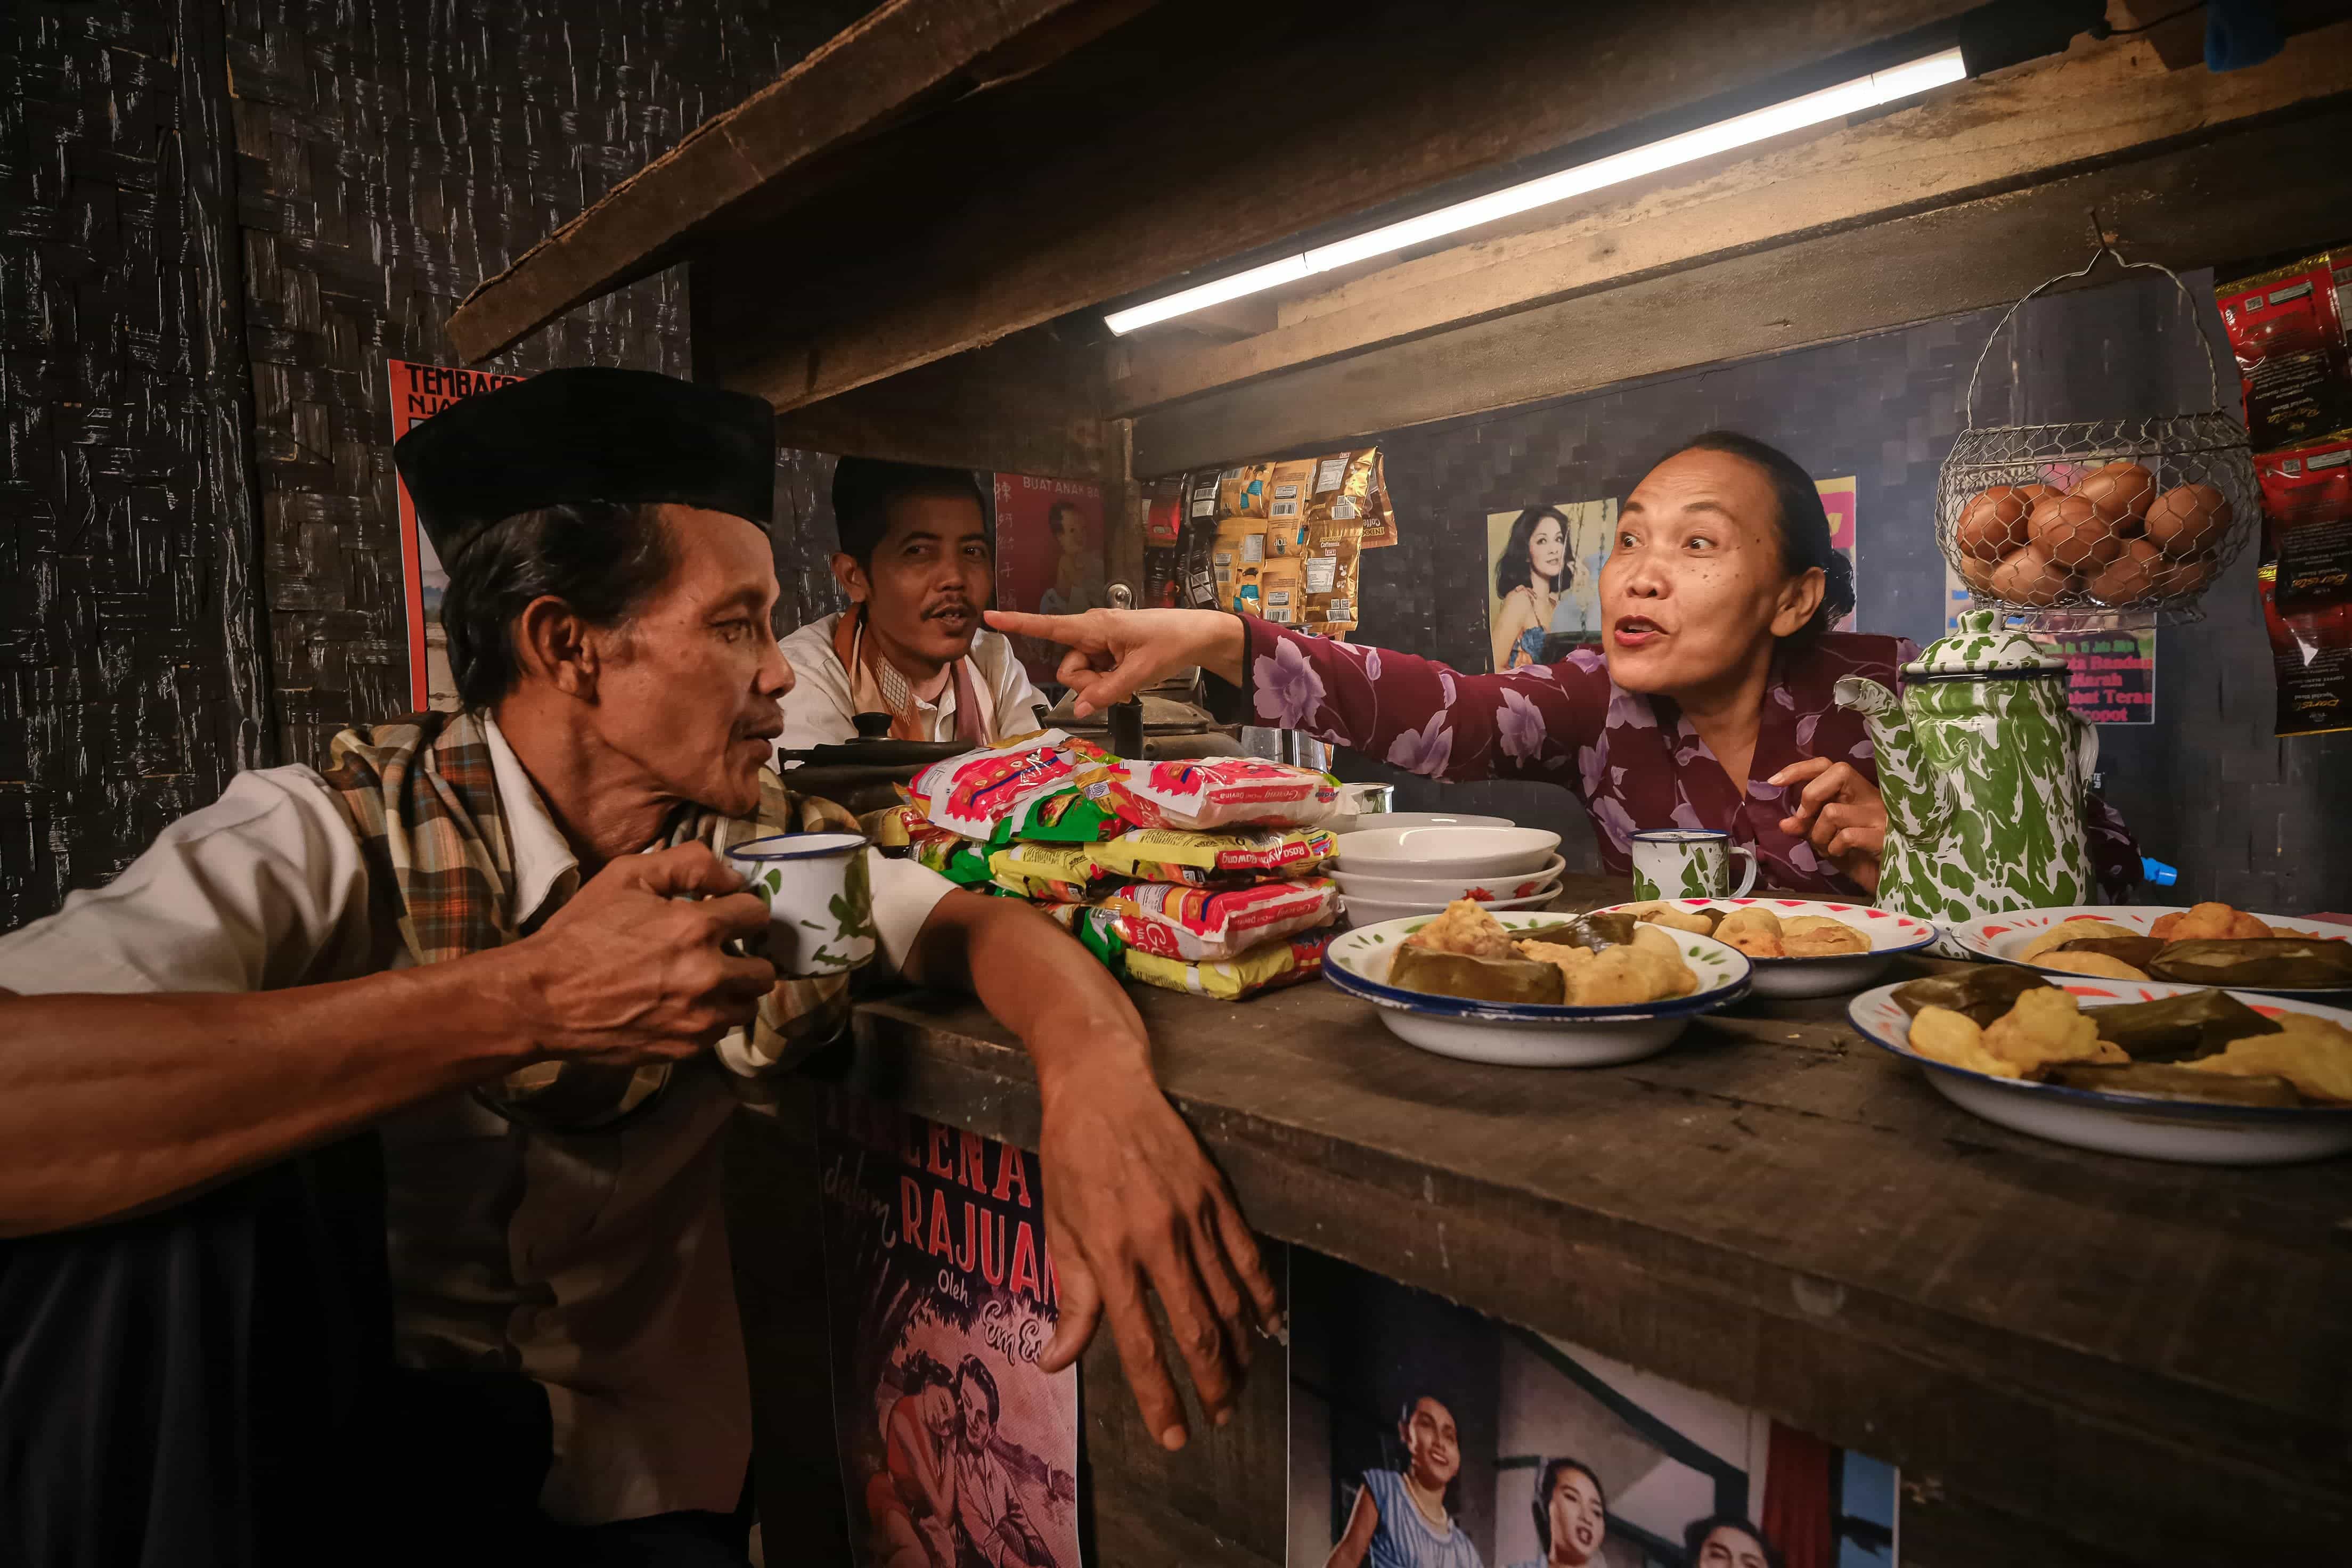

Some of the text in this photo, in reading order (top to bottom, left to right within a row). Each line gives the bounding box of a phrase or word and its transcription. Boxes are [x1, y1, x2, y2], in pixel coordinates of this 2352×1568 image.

[1022, 476, 1052, 492] BUAT
[1055, 480, 1084, 495] ANAK
[1274, 537, 1287, 546] TOP
[2070, 673, 2122, 688] Marah
[1265, 789, 1298, 800] Goreng
[1283, 845, 1304, 858] Rasa
[1222, 852, 1257, 865] Bawang
[981, 1300, 1015, 1367] Em
